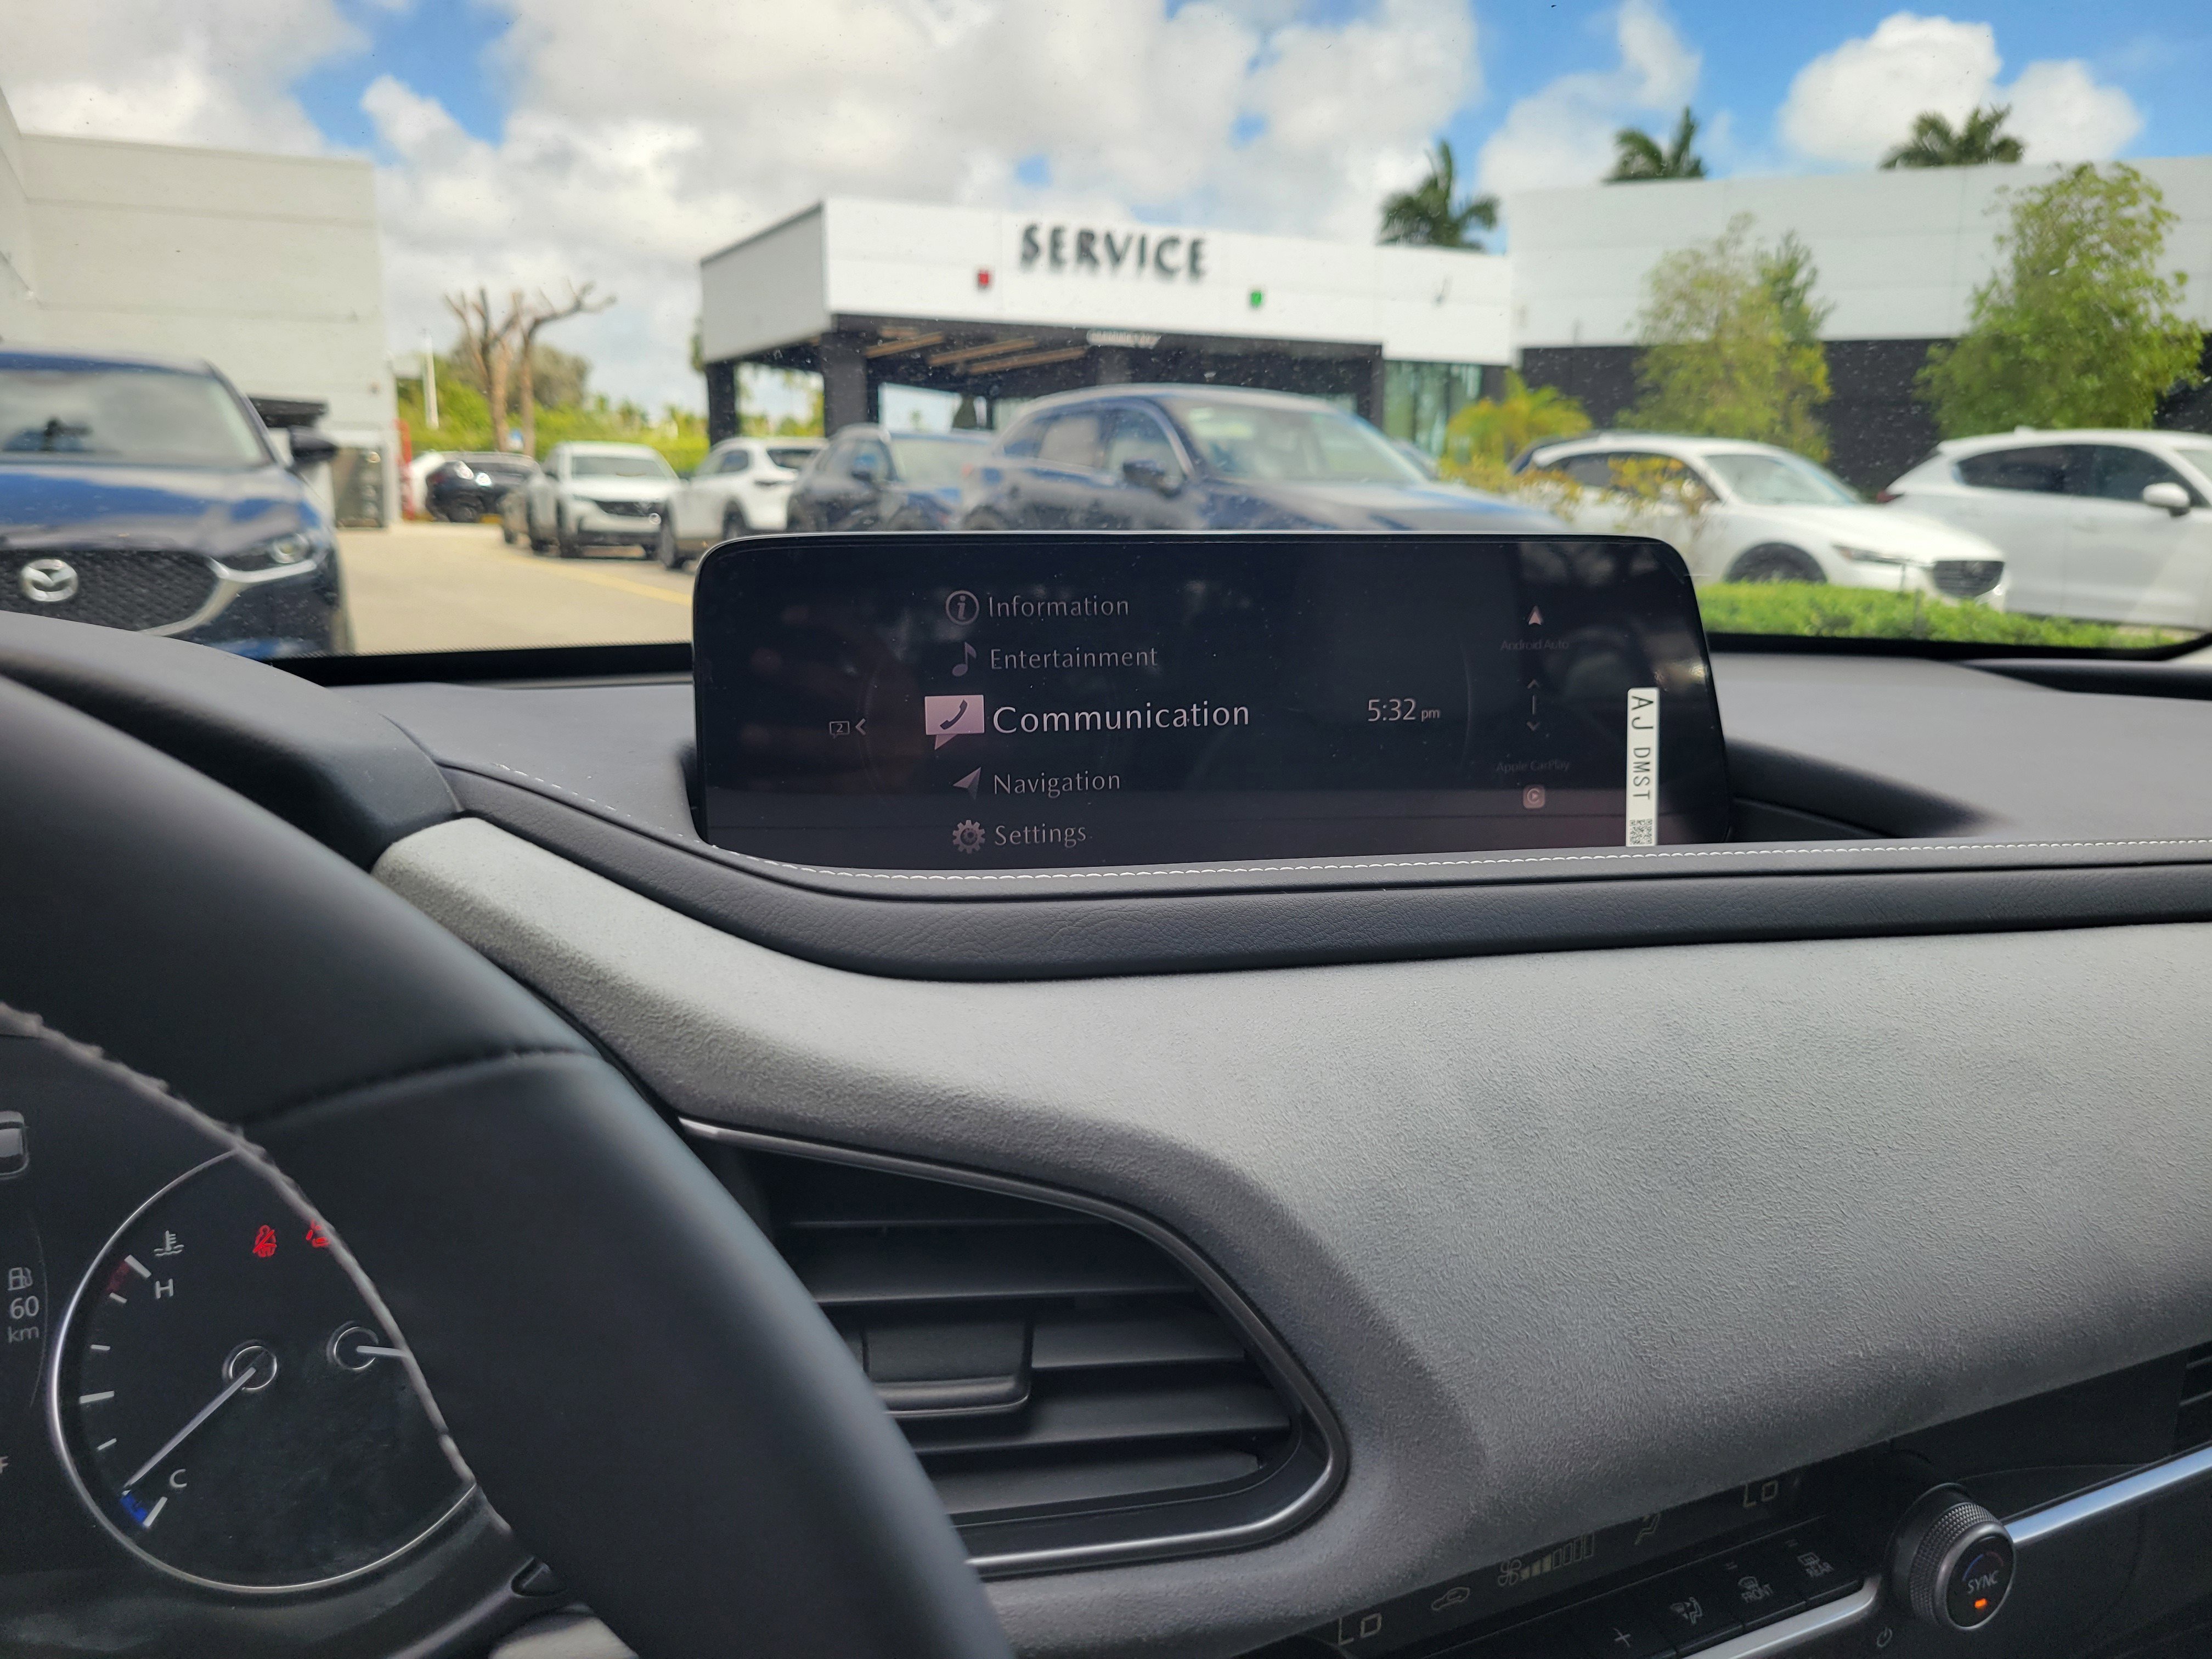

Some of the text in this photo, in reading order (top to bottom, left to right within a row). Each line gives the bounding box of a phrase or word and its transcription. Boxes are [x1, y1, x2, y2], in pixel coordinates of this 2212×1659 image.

[1020, 223, 1206, 281] SERVICE
[988, 595, 1129, 618] Information
[1500, 639, 1570, 651] Android Auto
[990, 647, 1158, 670] Entertainment
[993, 700, 1249, 734] Communication
[1368, 698, 1441, 722] 5:32 pm
[1630, 695, 1654, 800] AJ DMST
[1496, 758, 1570, 773] Apple CarPlay
[994, 770, 1120, 799] Navigation
[995, 823, 1086, 848] Settings
[155, 1278, 174, 1300] H
[9, 1295, 40, 1321] 60
[7, 1324, 40, 1344] km
[169, 1468, 188, 1488] C
[1967, 1570, 2000, 1595] SYNC
